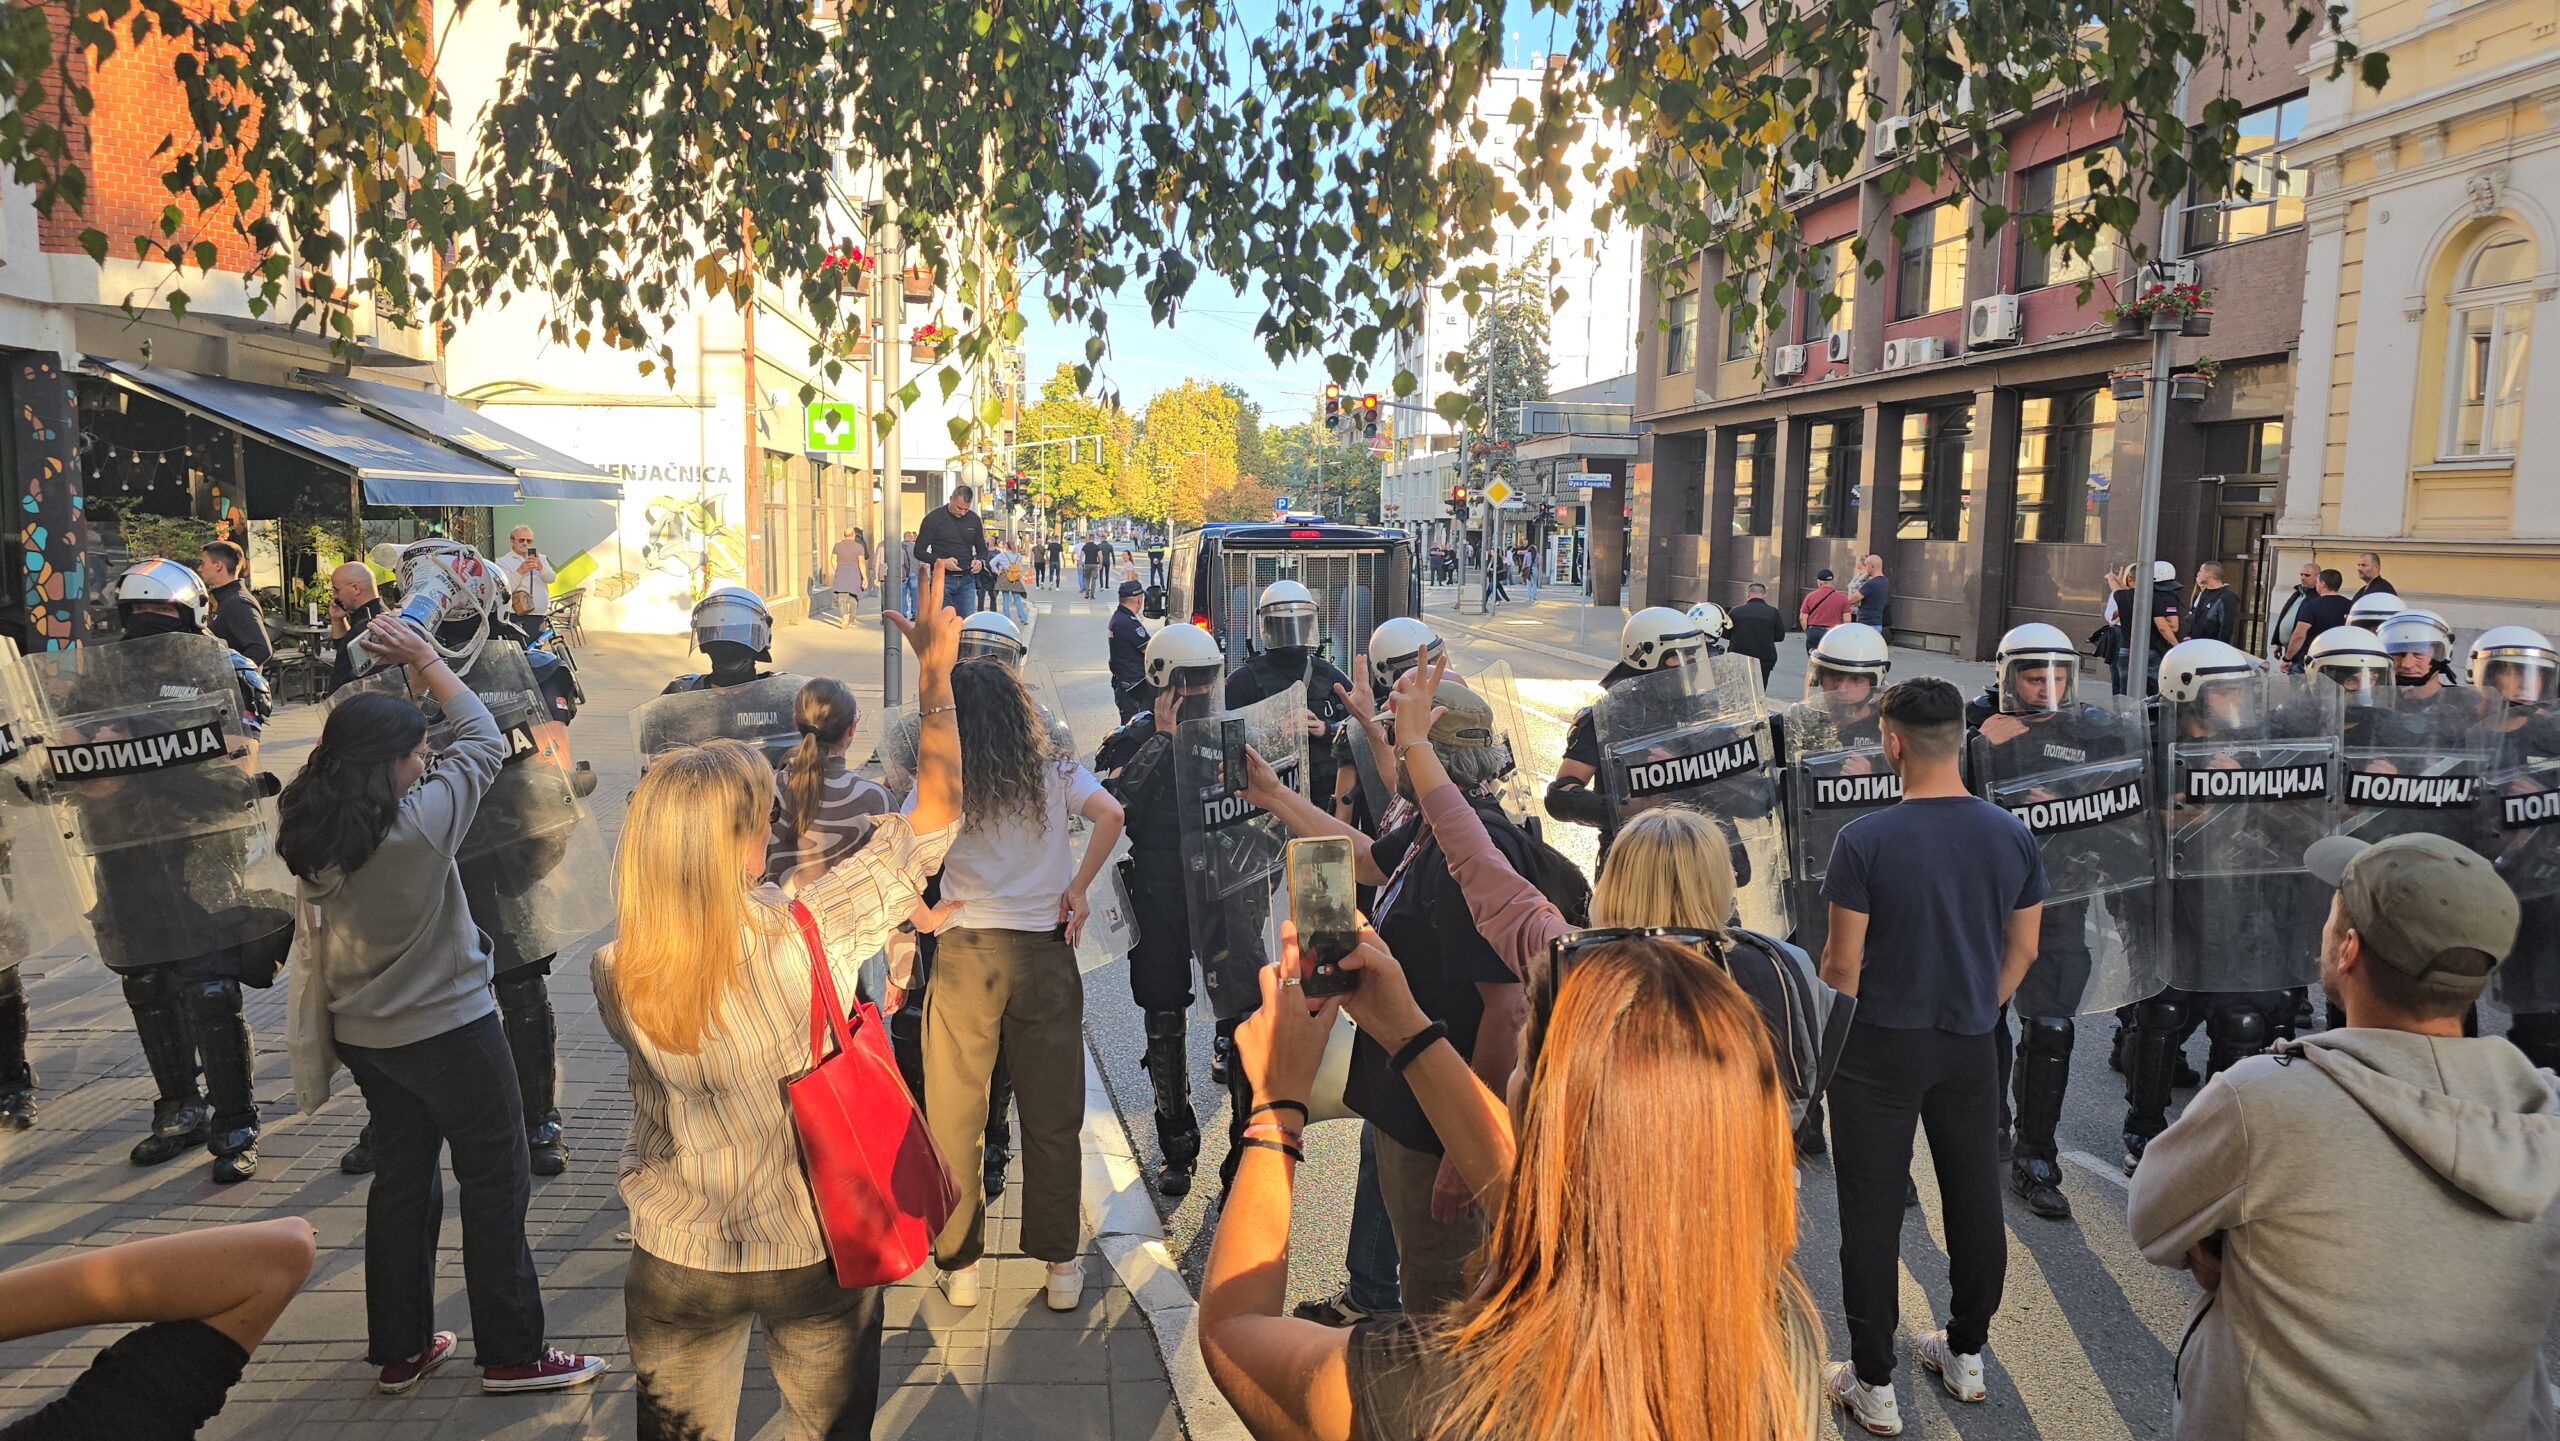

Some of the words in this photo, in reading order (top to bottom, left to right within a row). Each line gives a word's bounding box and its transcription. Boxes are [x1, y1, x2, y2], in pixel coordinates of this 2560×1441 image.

[599, 462, 732, 483] ENJAČNICA
[1279, 499, 1286, 509] P
[51, 727, 221, 774] ПОЛИЦИЈА
[2044, 743, 2086, 763] ПОЛИЦИЈА
[1630, 740, 1756, 790] ПОЛИЦИЈА
[2190, 766, 2325, 799] ПОЛИЦИЈА
